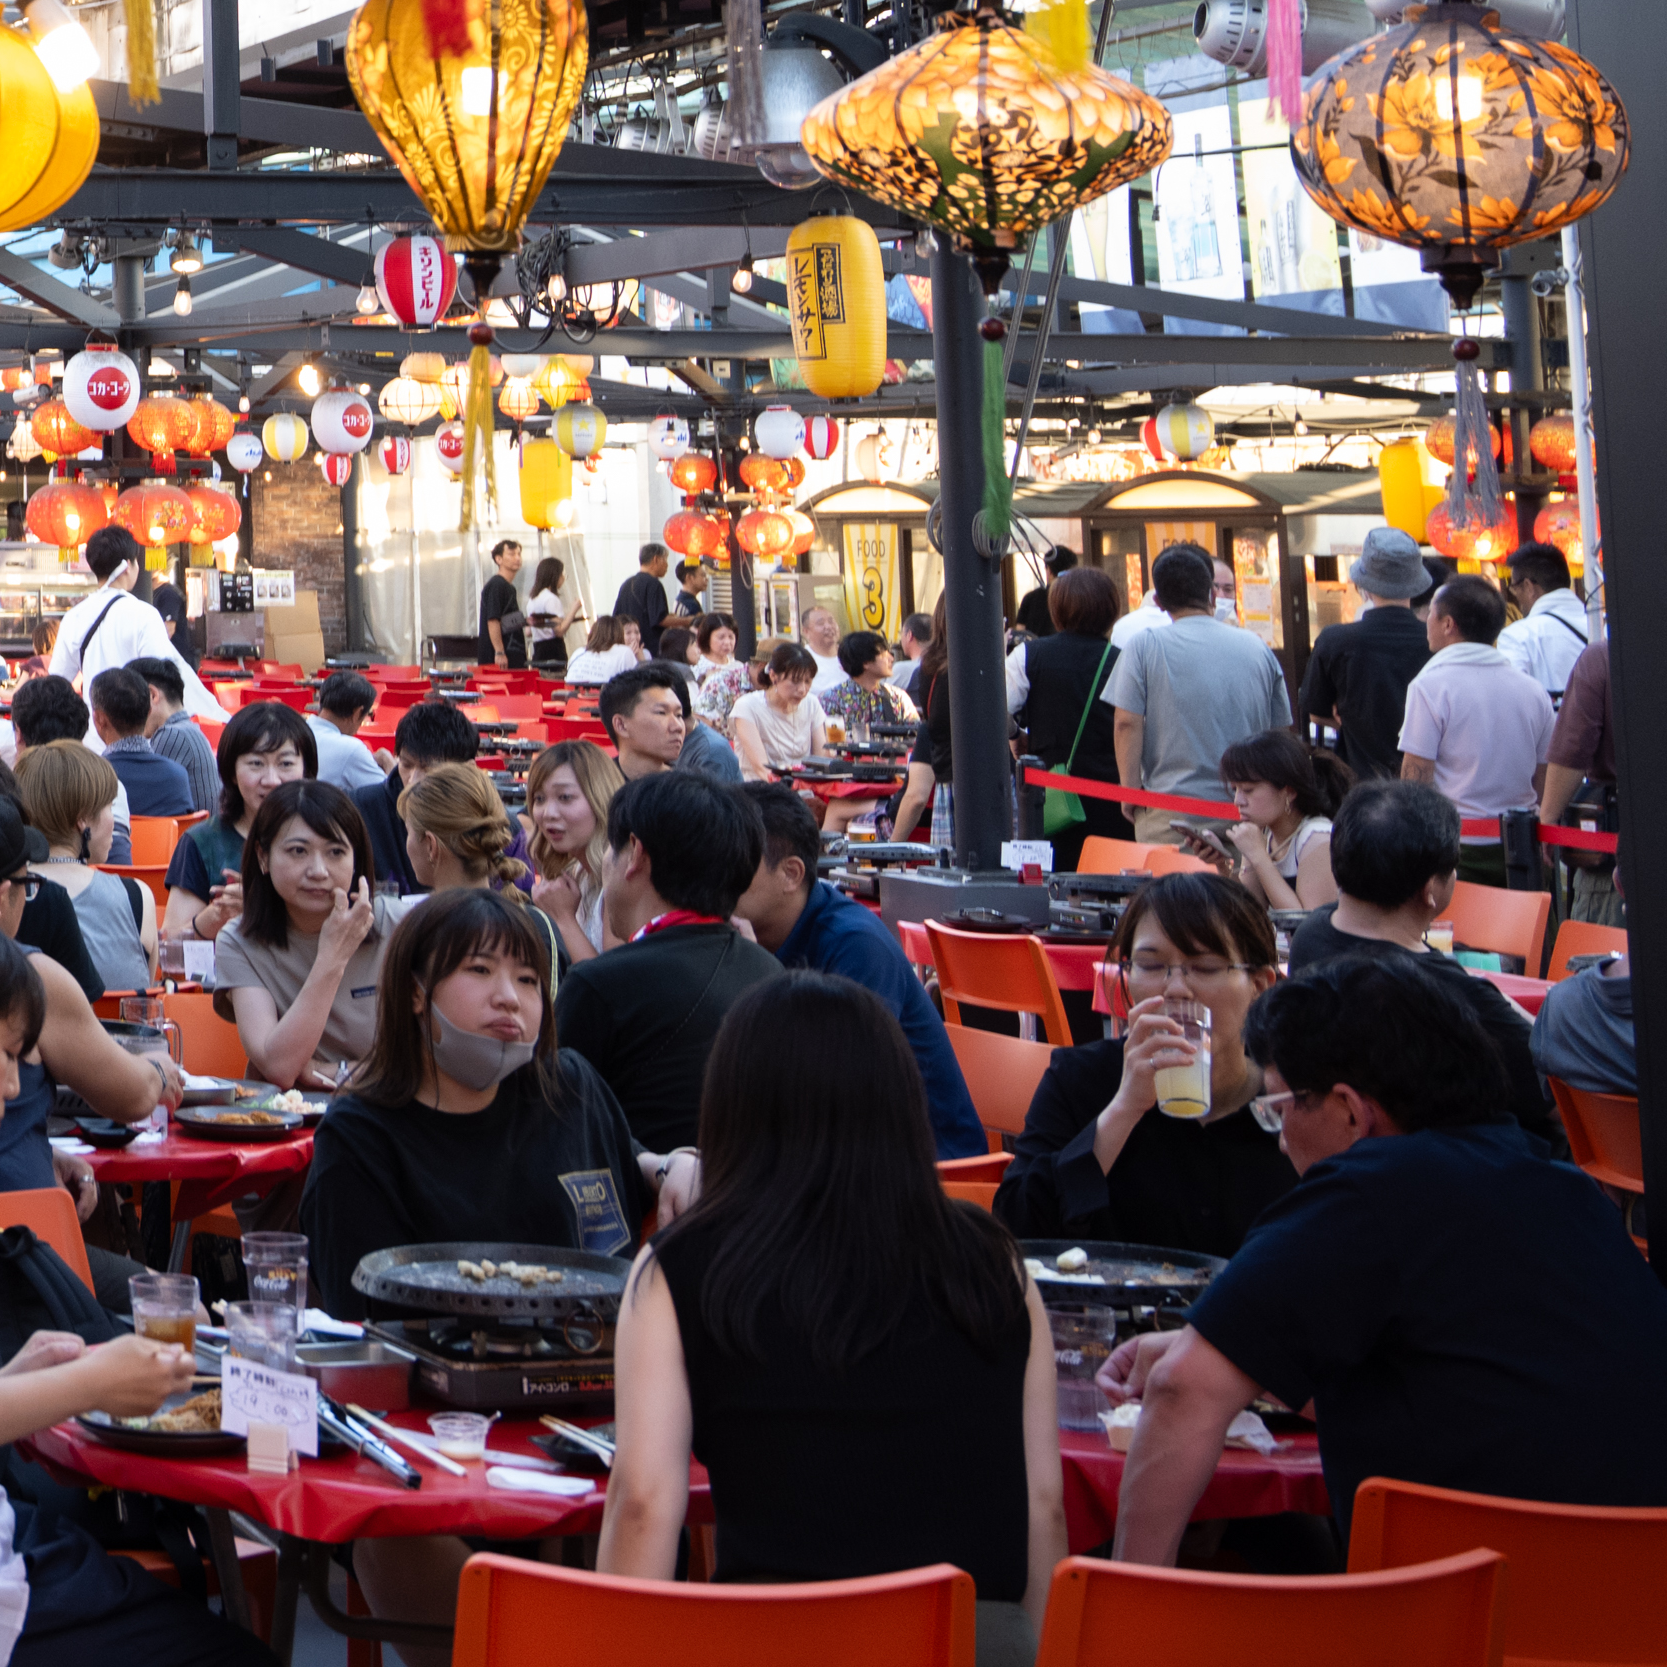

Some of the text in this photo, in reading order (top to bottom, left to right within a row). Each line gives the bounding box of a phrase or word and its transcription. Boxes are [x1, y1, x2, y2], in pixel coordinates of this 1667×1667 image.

[419, 246, 434, 310] キリンビール
[793, 257, 816, 351] レモンサワー
[88, 380, 131, 397] コカ・コーラ
[857, 539, 886, 558] FOOD
[862, 566, 885, 630] 3
